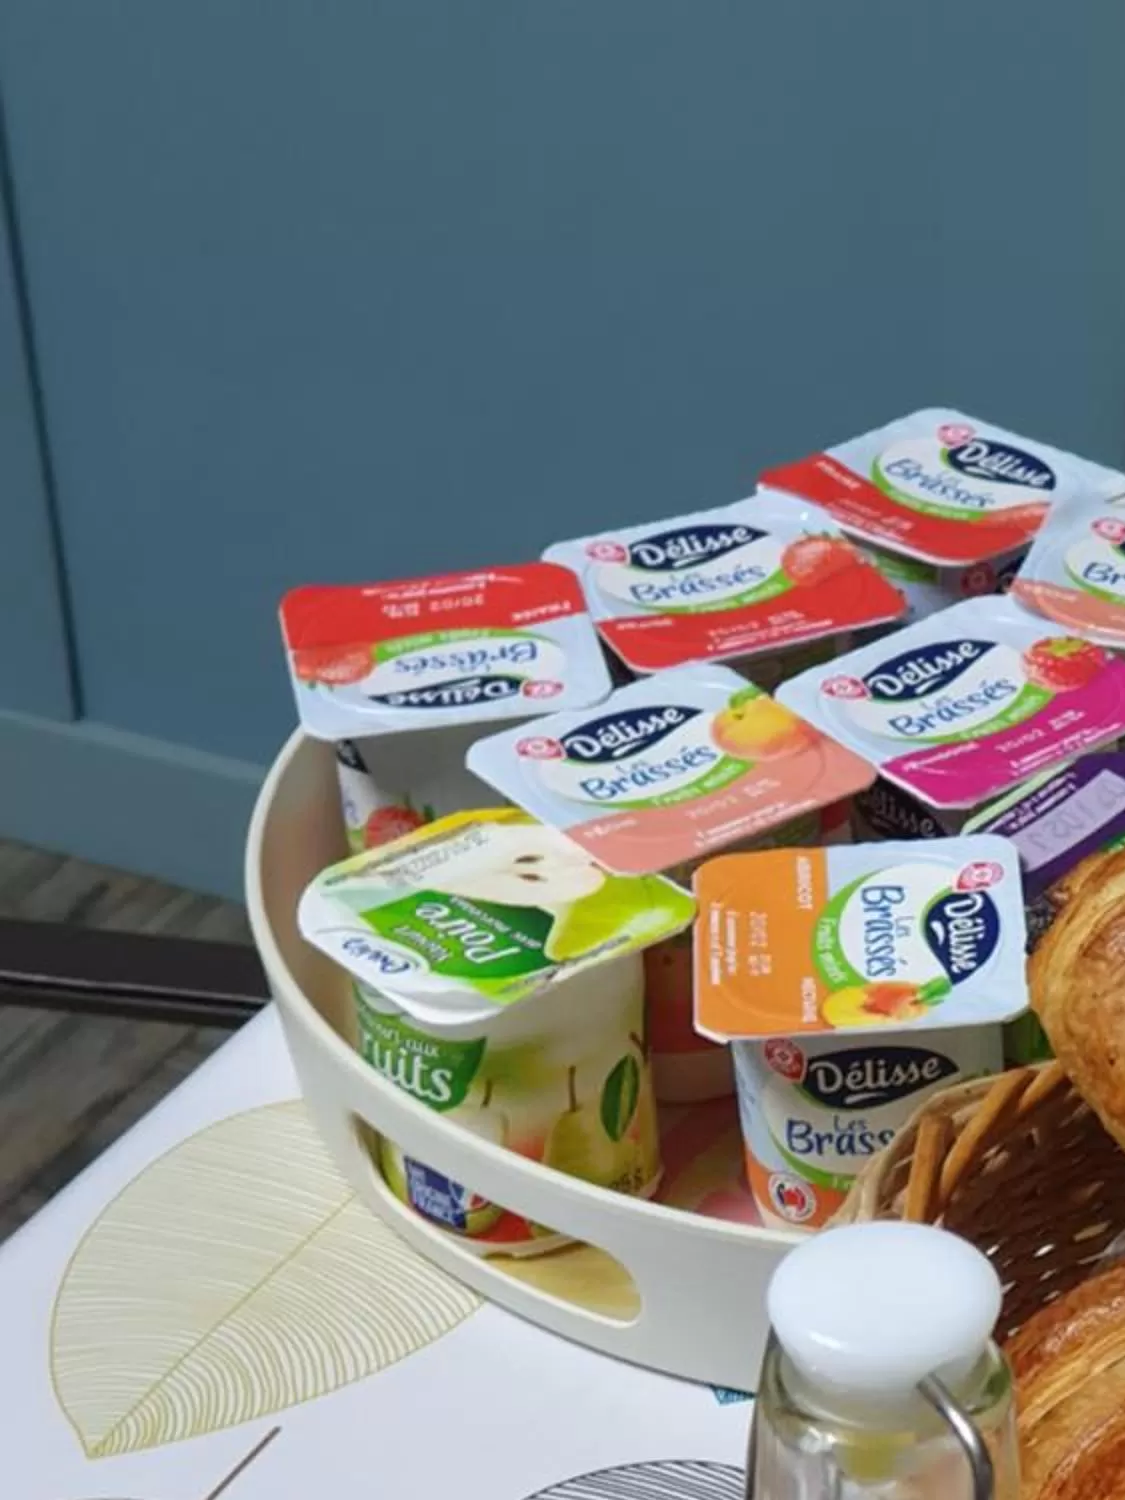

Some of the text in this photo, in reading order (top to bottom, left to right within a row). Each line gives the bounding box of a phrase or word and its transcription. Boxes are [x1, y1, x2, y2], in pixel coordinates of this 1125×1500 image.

[631, 527, 752, 567] Délisse
[629, 562, 766, 603] Brassés
[868, 641, 980, 697] Délisse
[564, 708, 685, 759] Délisse
[888, 678, 1018, 737] Brassés
[579, 745, 717, 801] Brassés
[415, 902, 521, 964] Poire
[861, 885, 908, 977] Brassés
[943, 893, 986, 974] Délisse
[360, 1030, 454, 1103] ruits
[809, 1057, 942, 1094] Délisse
[786, 1117, 896, 1156] Brass
[833, 1114, 868, 1133] Les
